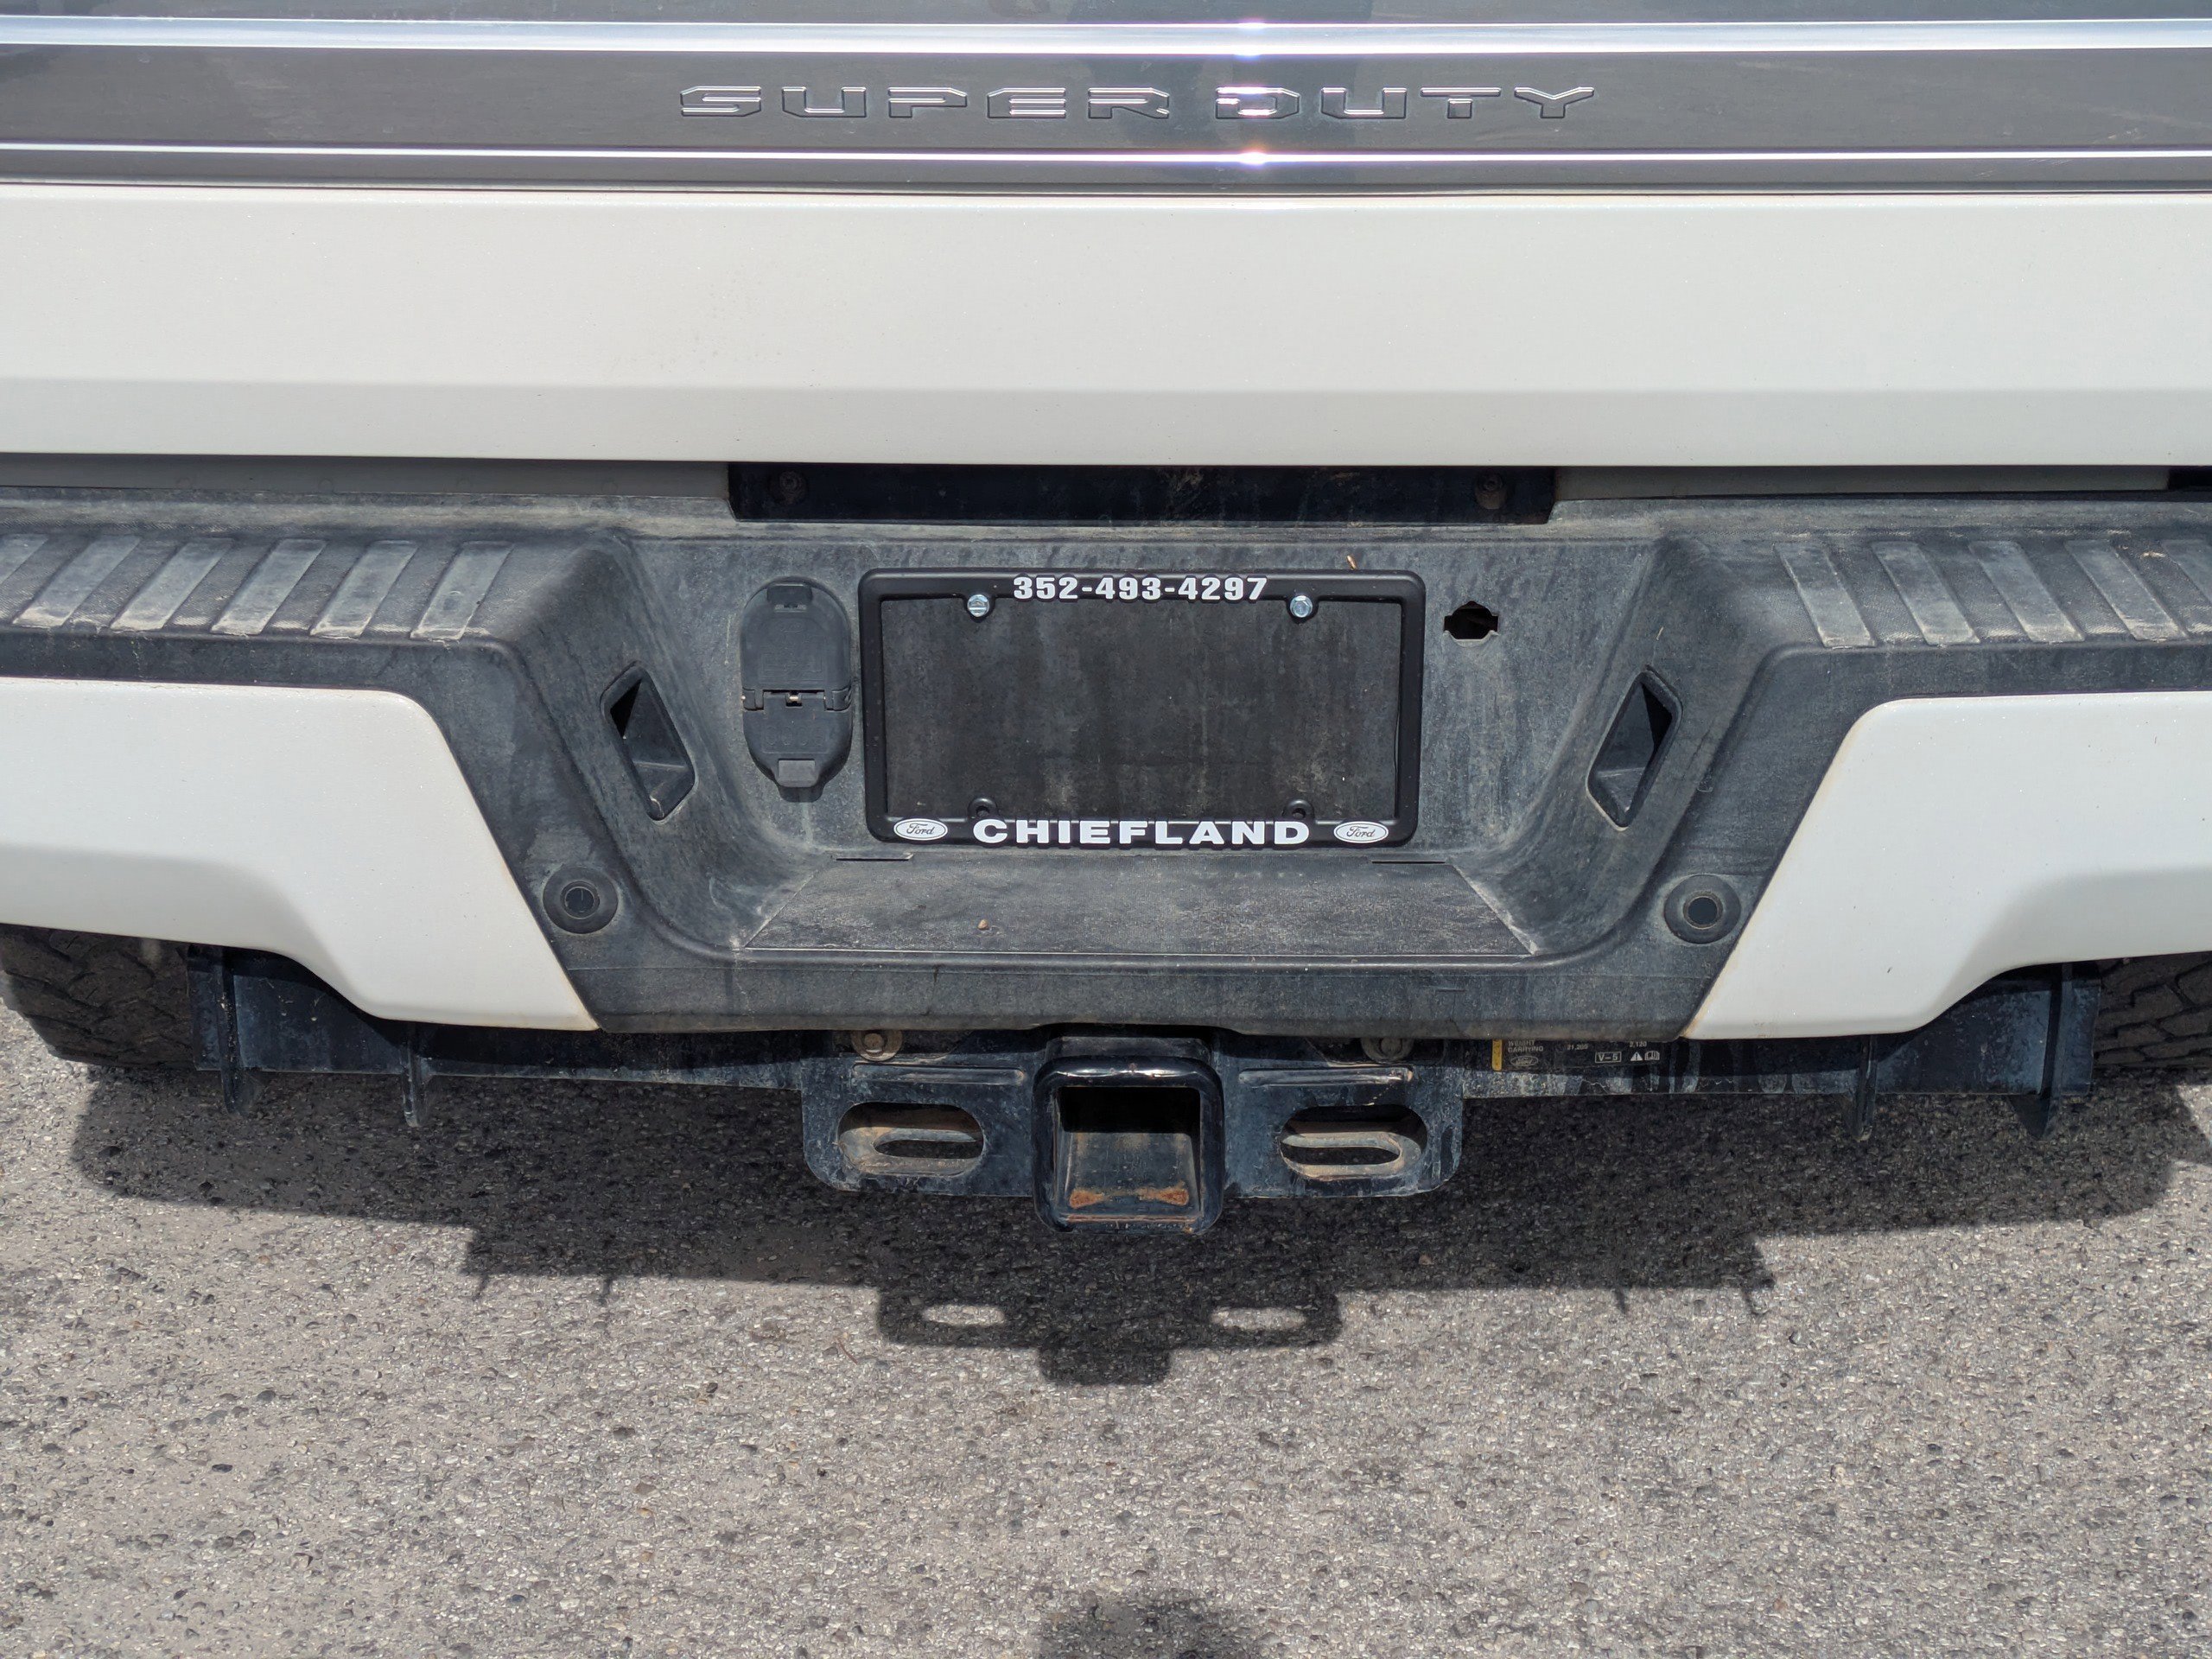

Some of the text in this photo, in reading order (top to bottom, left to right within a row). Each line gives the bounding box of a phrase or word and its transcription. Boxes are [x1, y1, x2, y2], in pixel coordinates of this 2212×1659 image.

[680, 85, 1596, 119] SUPER DUTY
[1013, 575, 1268, 601] 352-493-4297
[906, 822, 936, 836] Ford
[973, 818, 1310, 845] CHIEFLAND
[1346, 825, 1376, 838] Ford
